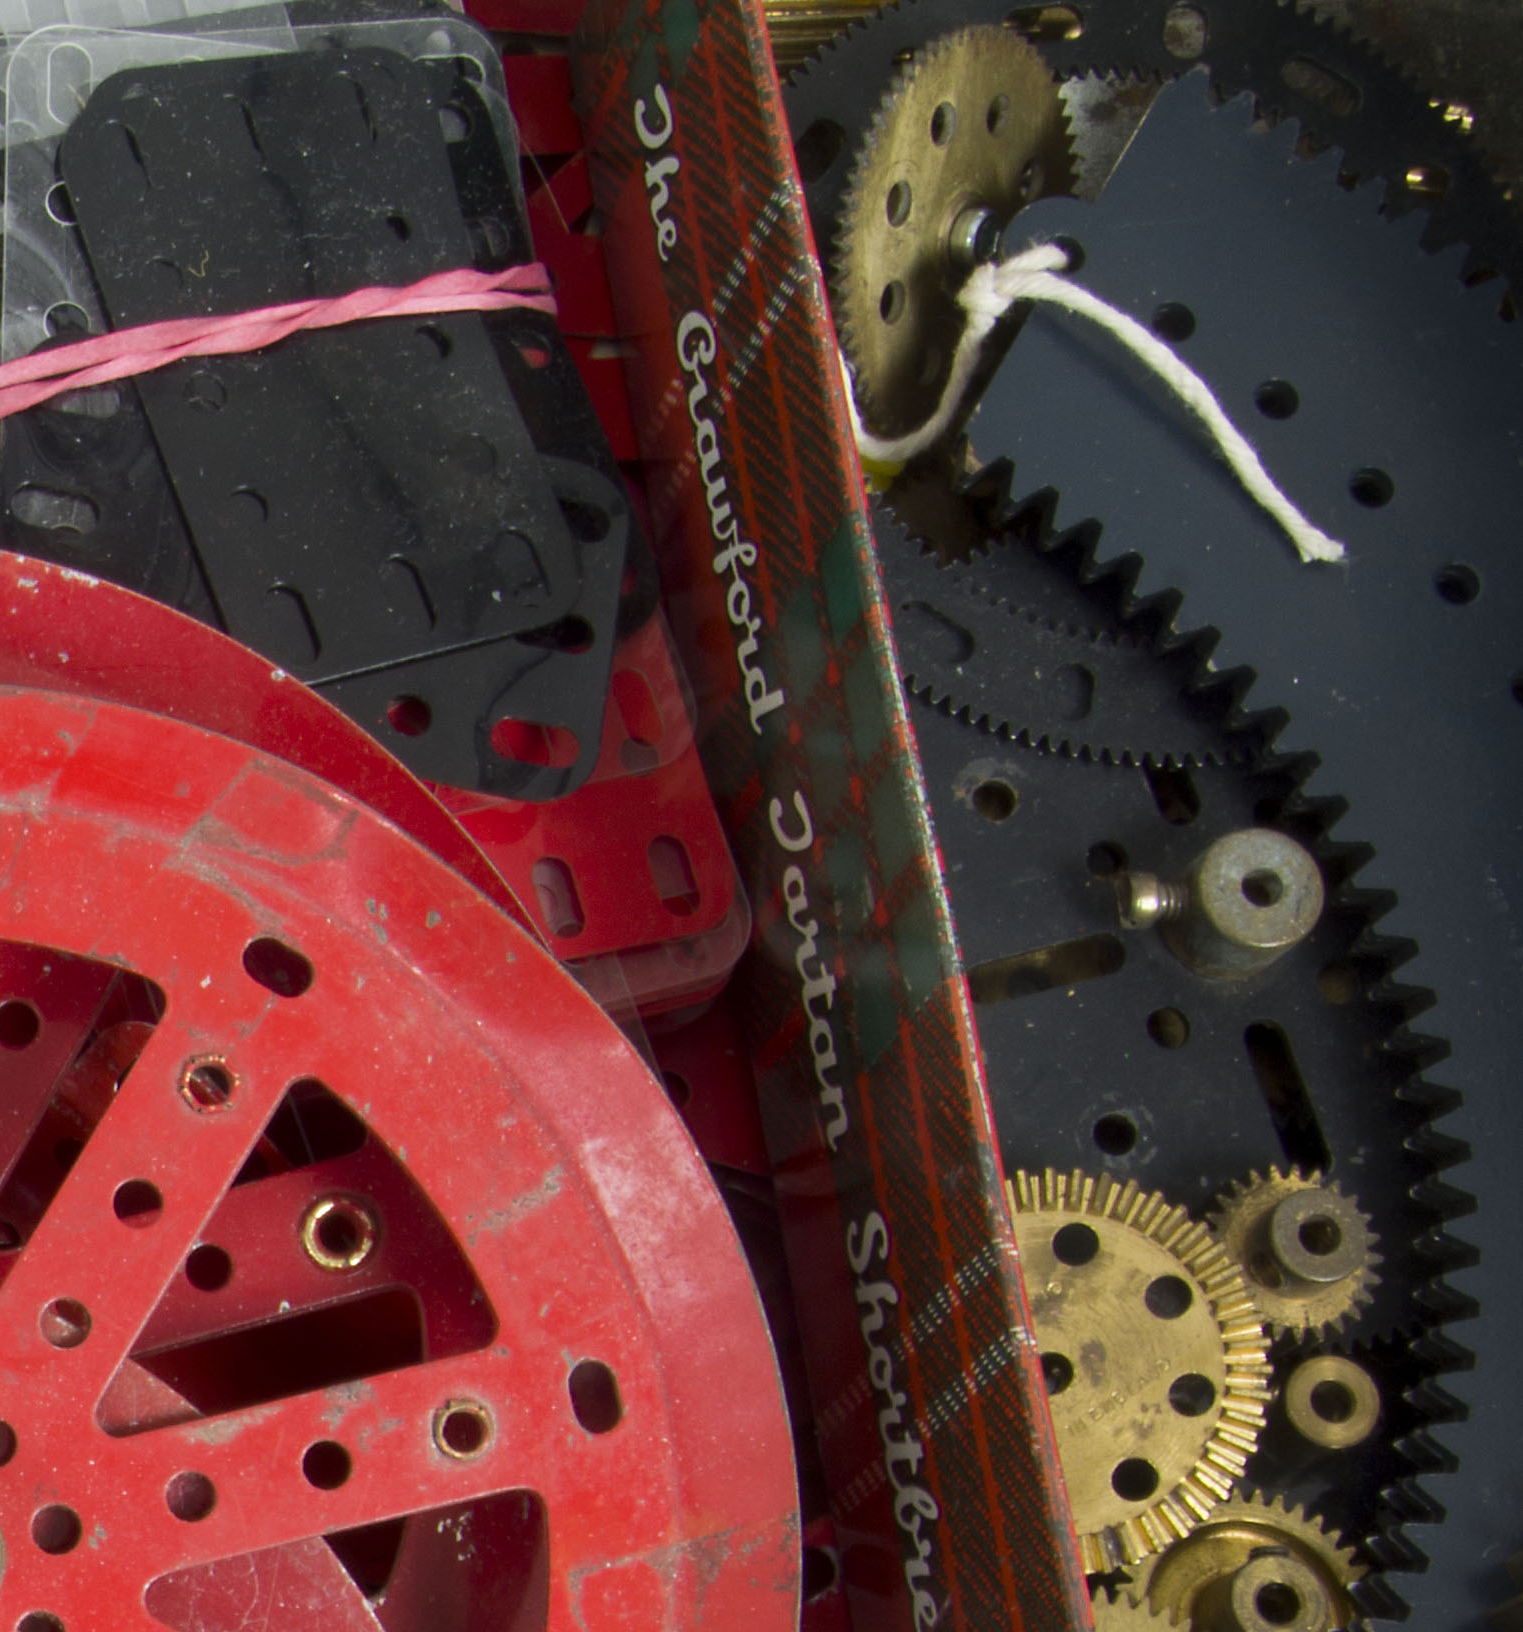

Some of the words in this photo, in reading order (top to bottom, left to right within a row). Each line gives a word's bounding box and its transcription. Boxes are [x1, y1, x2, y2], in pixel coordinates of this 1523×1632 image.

[635, 84, 680, 263] The
[675, 310, 787, 735] Crawford
[768, 789, 848, 1153] Tartan
